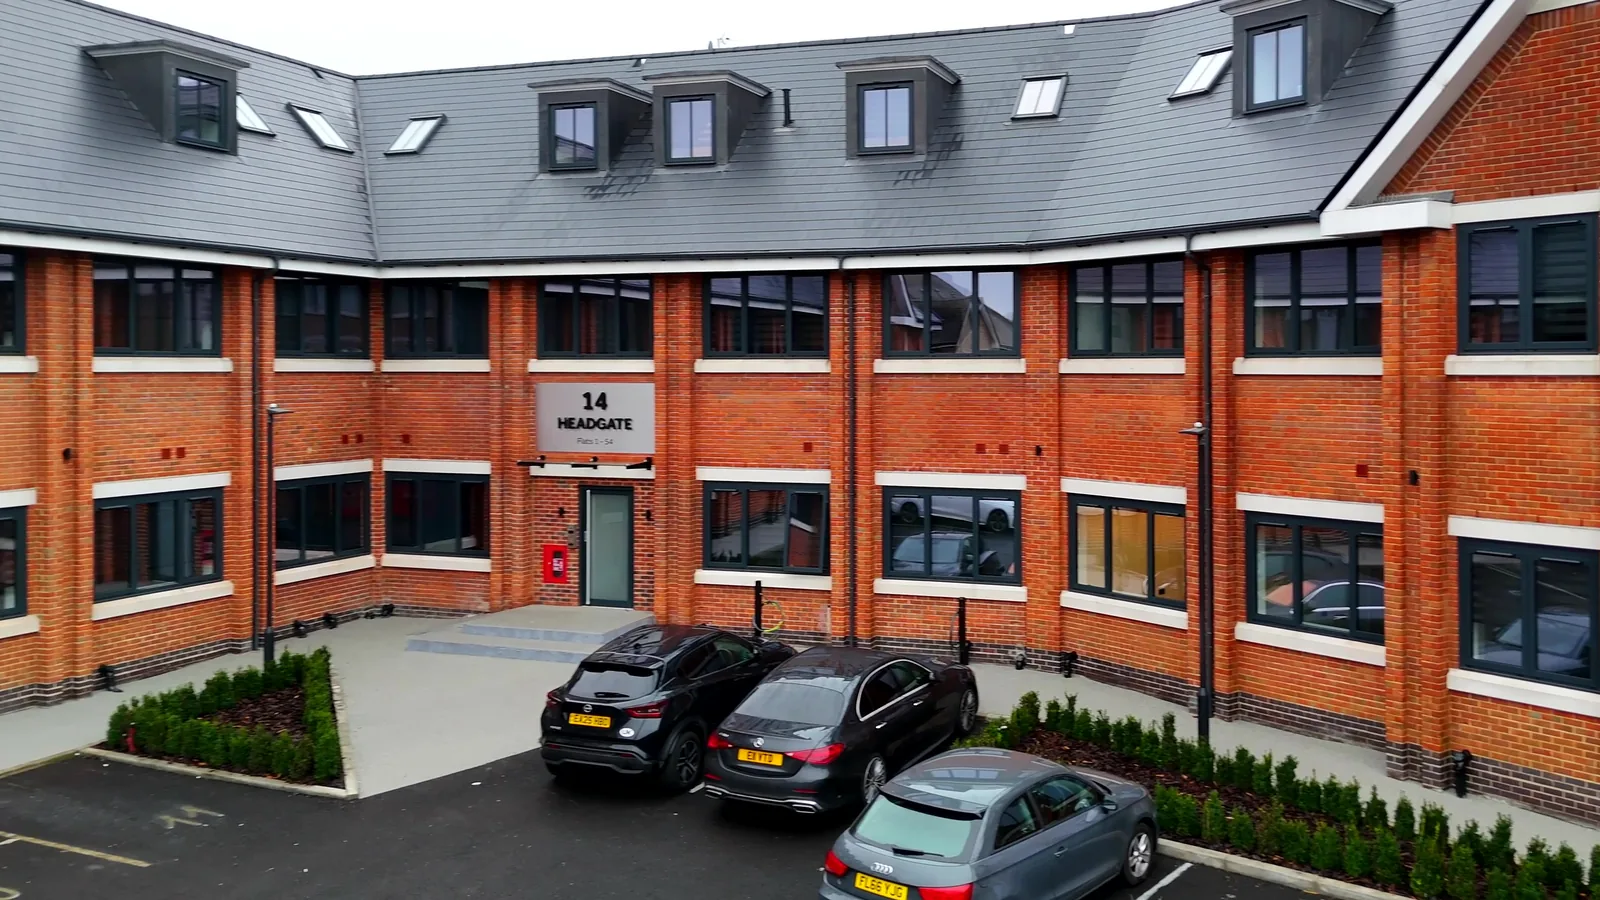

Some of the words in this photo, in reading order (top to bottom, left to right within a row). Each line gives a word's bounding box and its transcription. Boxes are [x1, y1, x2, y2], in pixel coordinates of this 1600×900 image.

[582, 391, 608, 411] 14
[557, 417, 633, 431] HEADGATE
[577, 437, 594, 445] Flats
[860, 875, 882, 892] FL66
[884, 883, 903, 898] YJG
